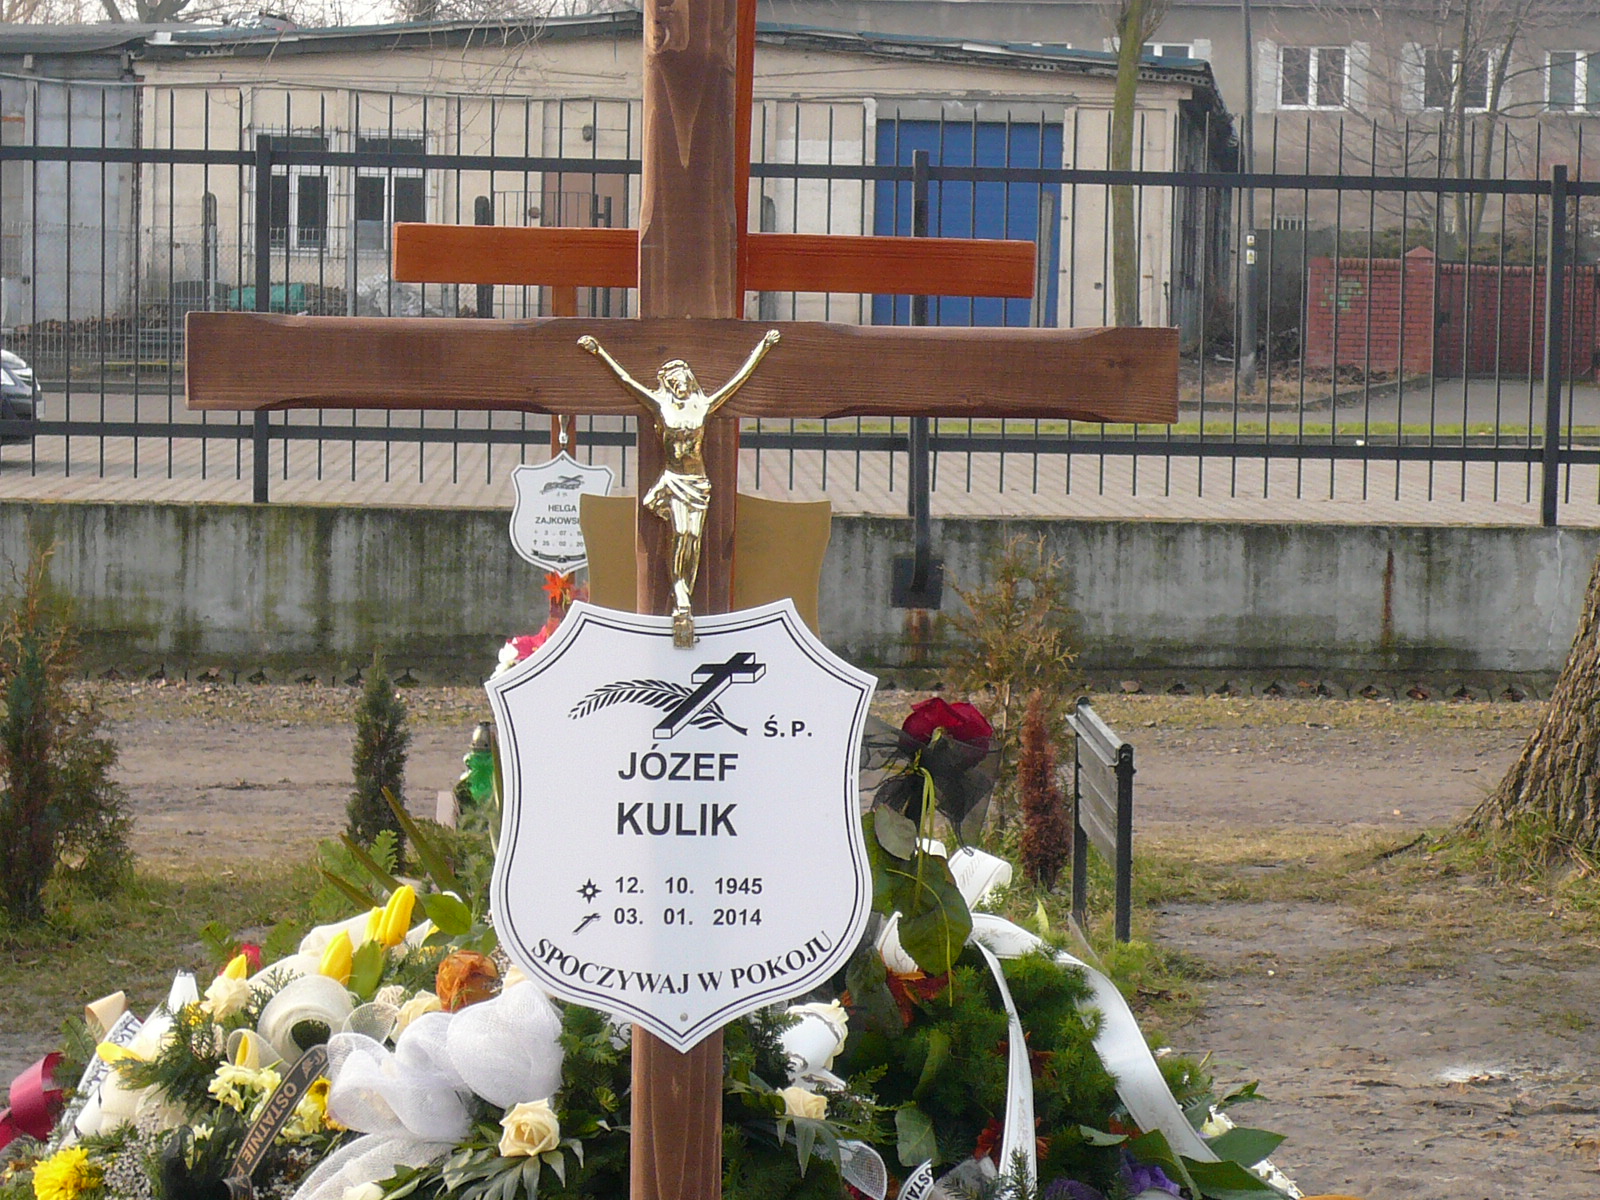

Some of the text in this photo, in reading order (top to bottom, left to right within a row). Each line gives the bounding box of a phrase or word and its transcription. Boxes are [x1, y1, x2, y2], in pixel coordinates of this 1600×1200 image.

[547, 504, 577, 513] HELGA
[618, 743, 738, 782] JÓZEF
[617, 802, 738, 837] KULIK
[615, 876, 763, 895] 12. 10. 1945
[614, 907, 762, 926] 03. 01. 2014
[532, 930, 832, 994] SPOCZYWAJ W POKOJU
[242, 1082, 297, 1165] OSTATNIE
